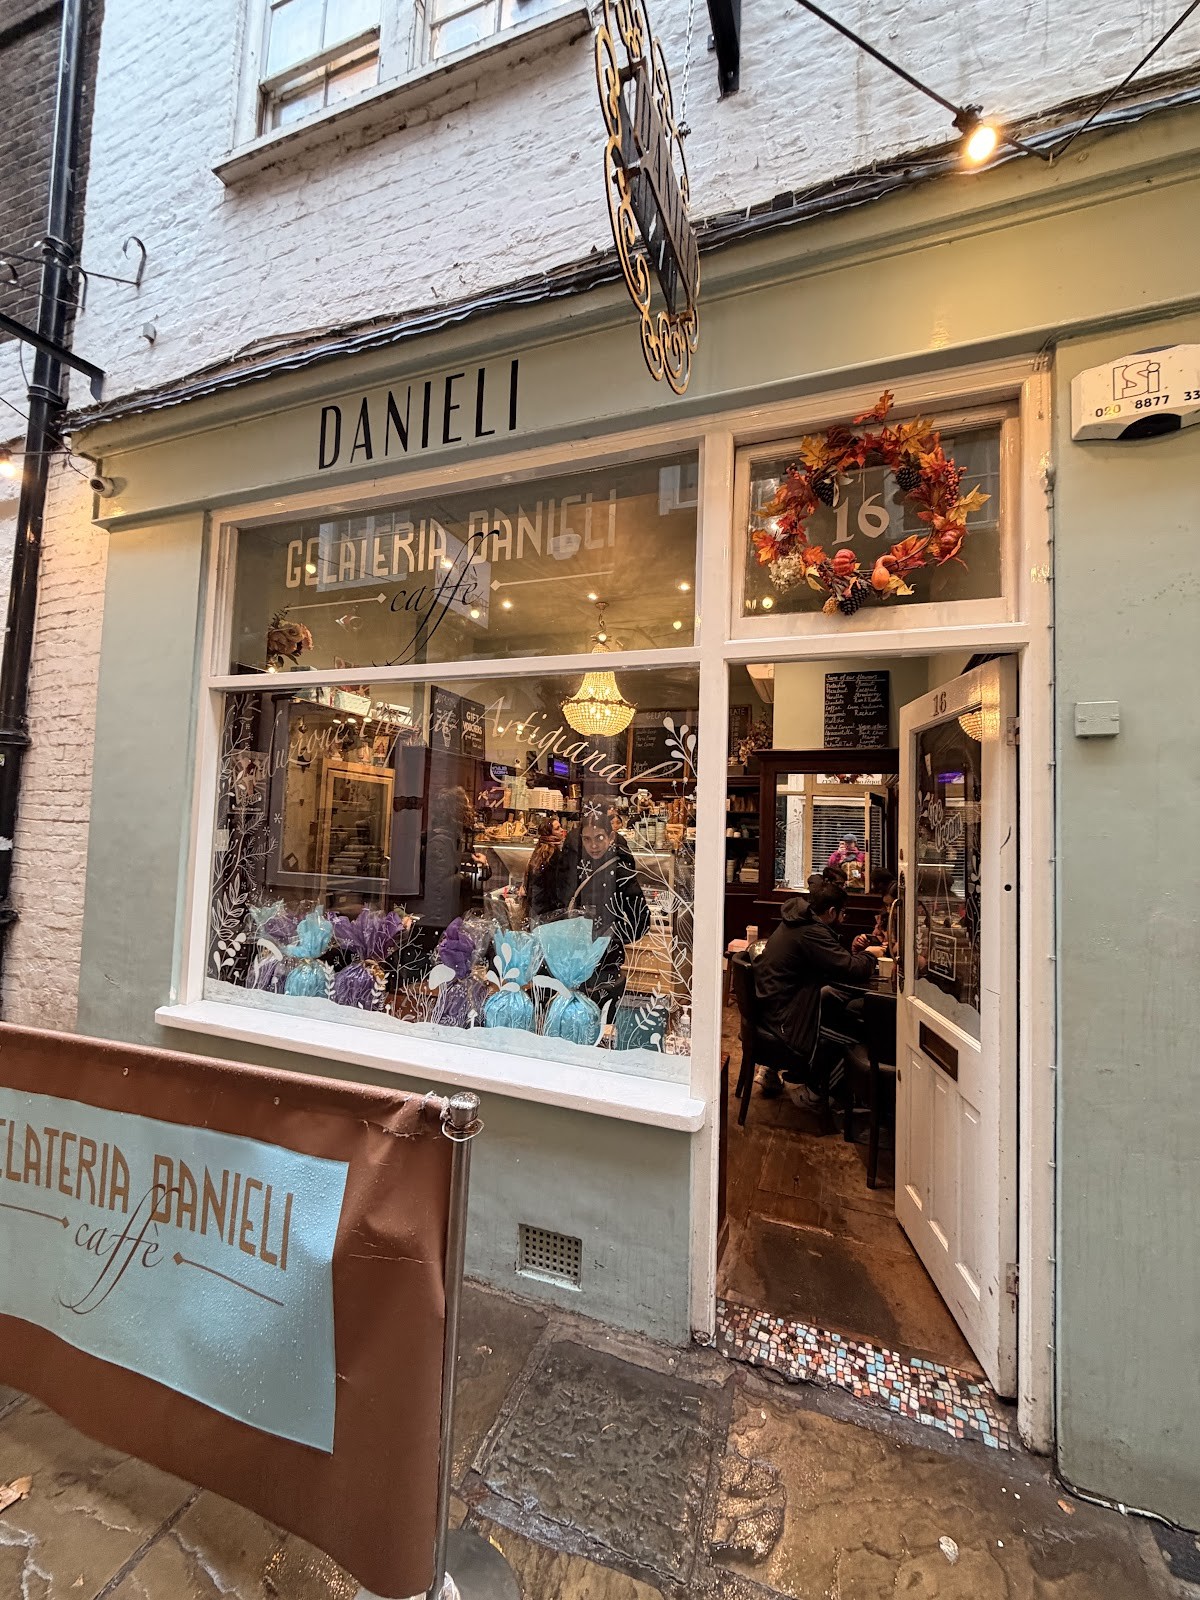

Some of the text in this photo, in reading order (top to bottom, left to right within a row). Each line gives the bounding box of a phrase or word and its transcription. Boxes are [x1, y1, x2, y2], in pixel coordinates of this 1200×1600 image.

[319, 359, 519, 470] DANIELI
[1095, 404, 1121, 417] 020
[1135, 395, 1170, 409] 8877
[286, 517, 447, 588] GELATERIA
[468, 489, 617, 564] DANIELI
[832, 492, 890, 546] 16
[466, 711, 479, 723] GIFT
[932, 691, 947, 717] 16
[931, 947, 953, 969] OPEN
[150, 1154, 294, 1271] DANIELI
[58, 1184, 181, 1314] caffè
